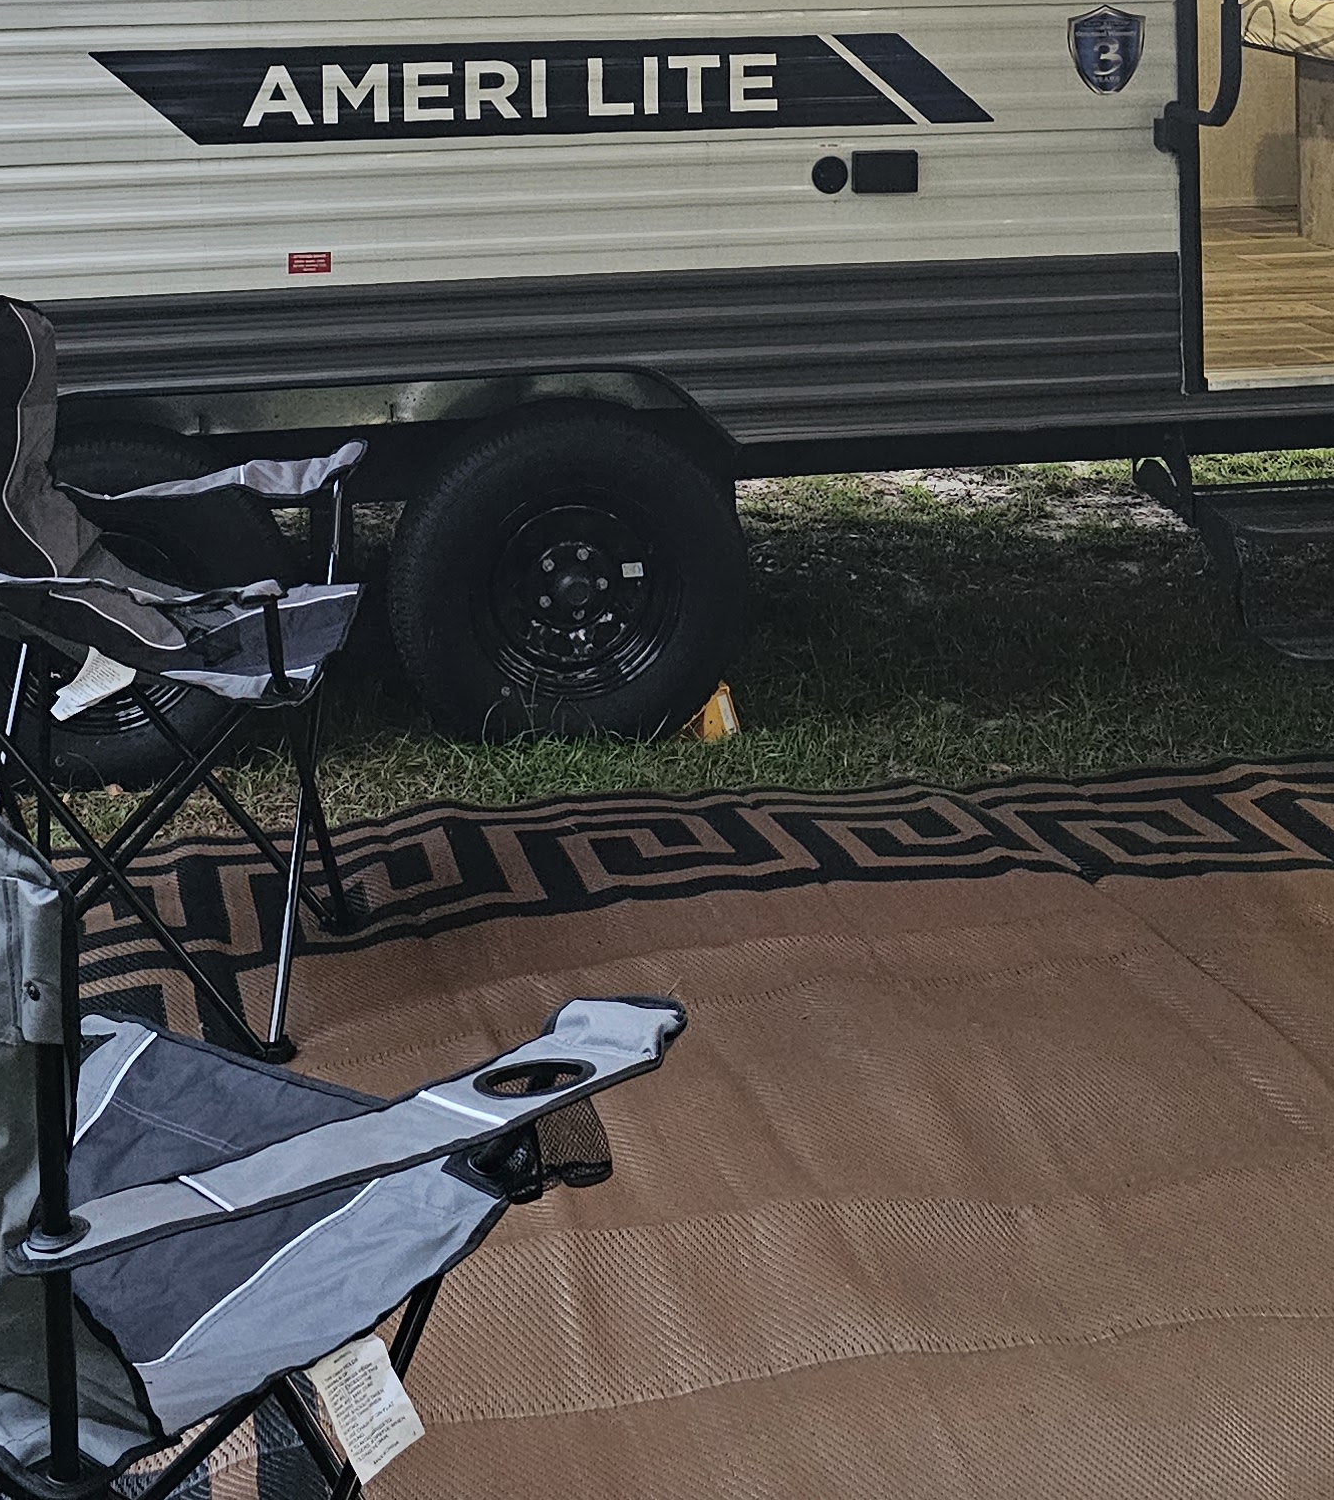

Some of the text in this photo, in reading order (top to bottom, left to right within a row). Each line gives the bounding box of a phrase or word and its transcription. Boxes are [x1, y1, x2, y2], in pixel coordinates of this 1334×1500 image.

[1091, 38, 1124, 75] 3
[242, 53, 779, 128] AMERI LITE
